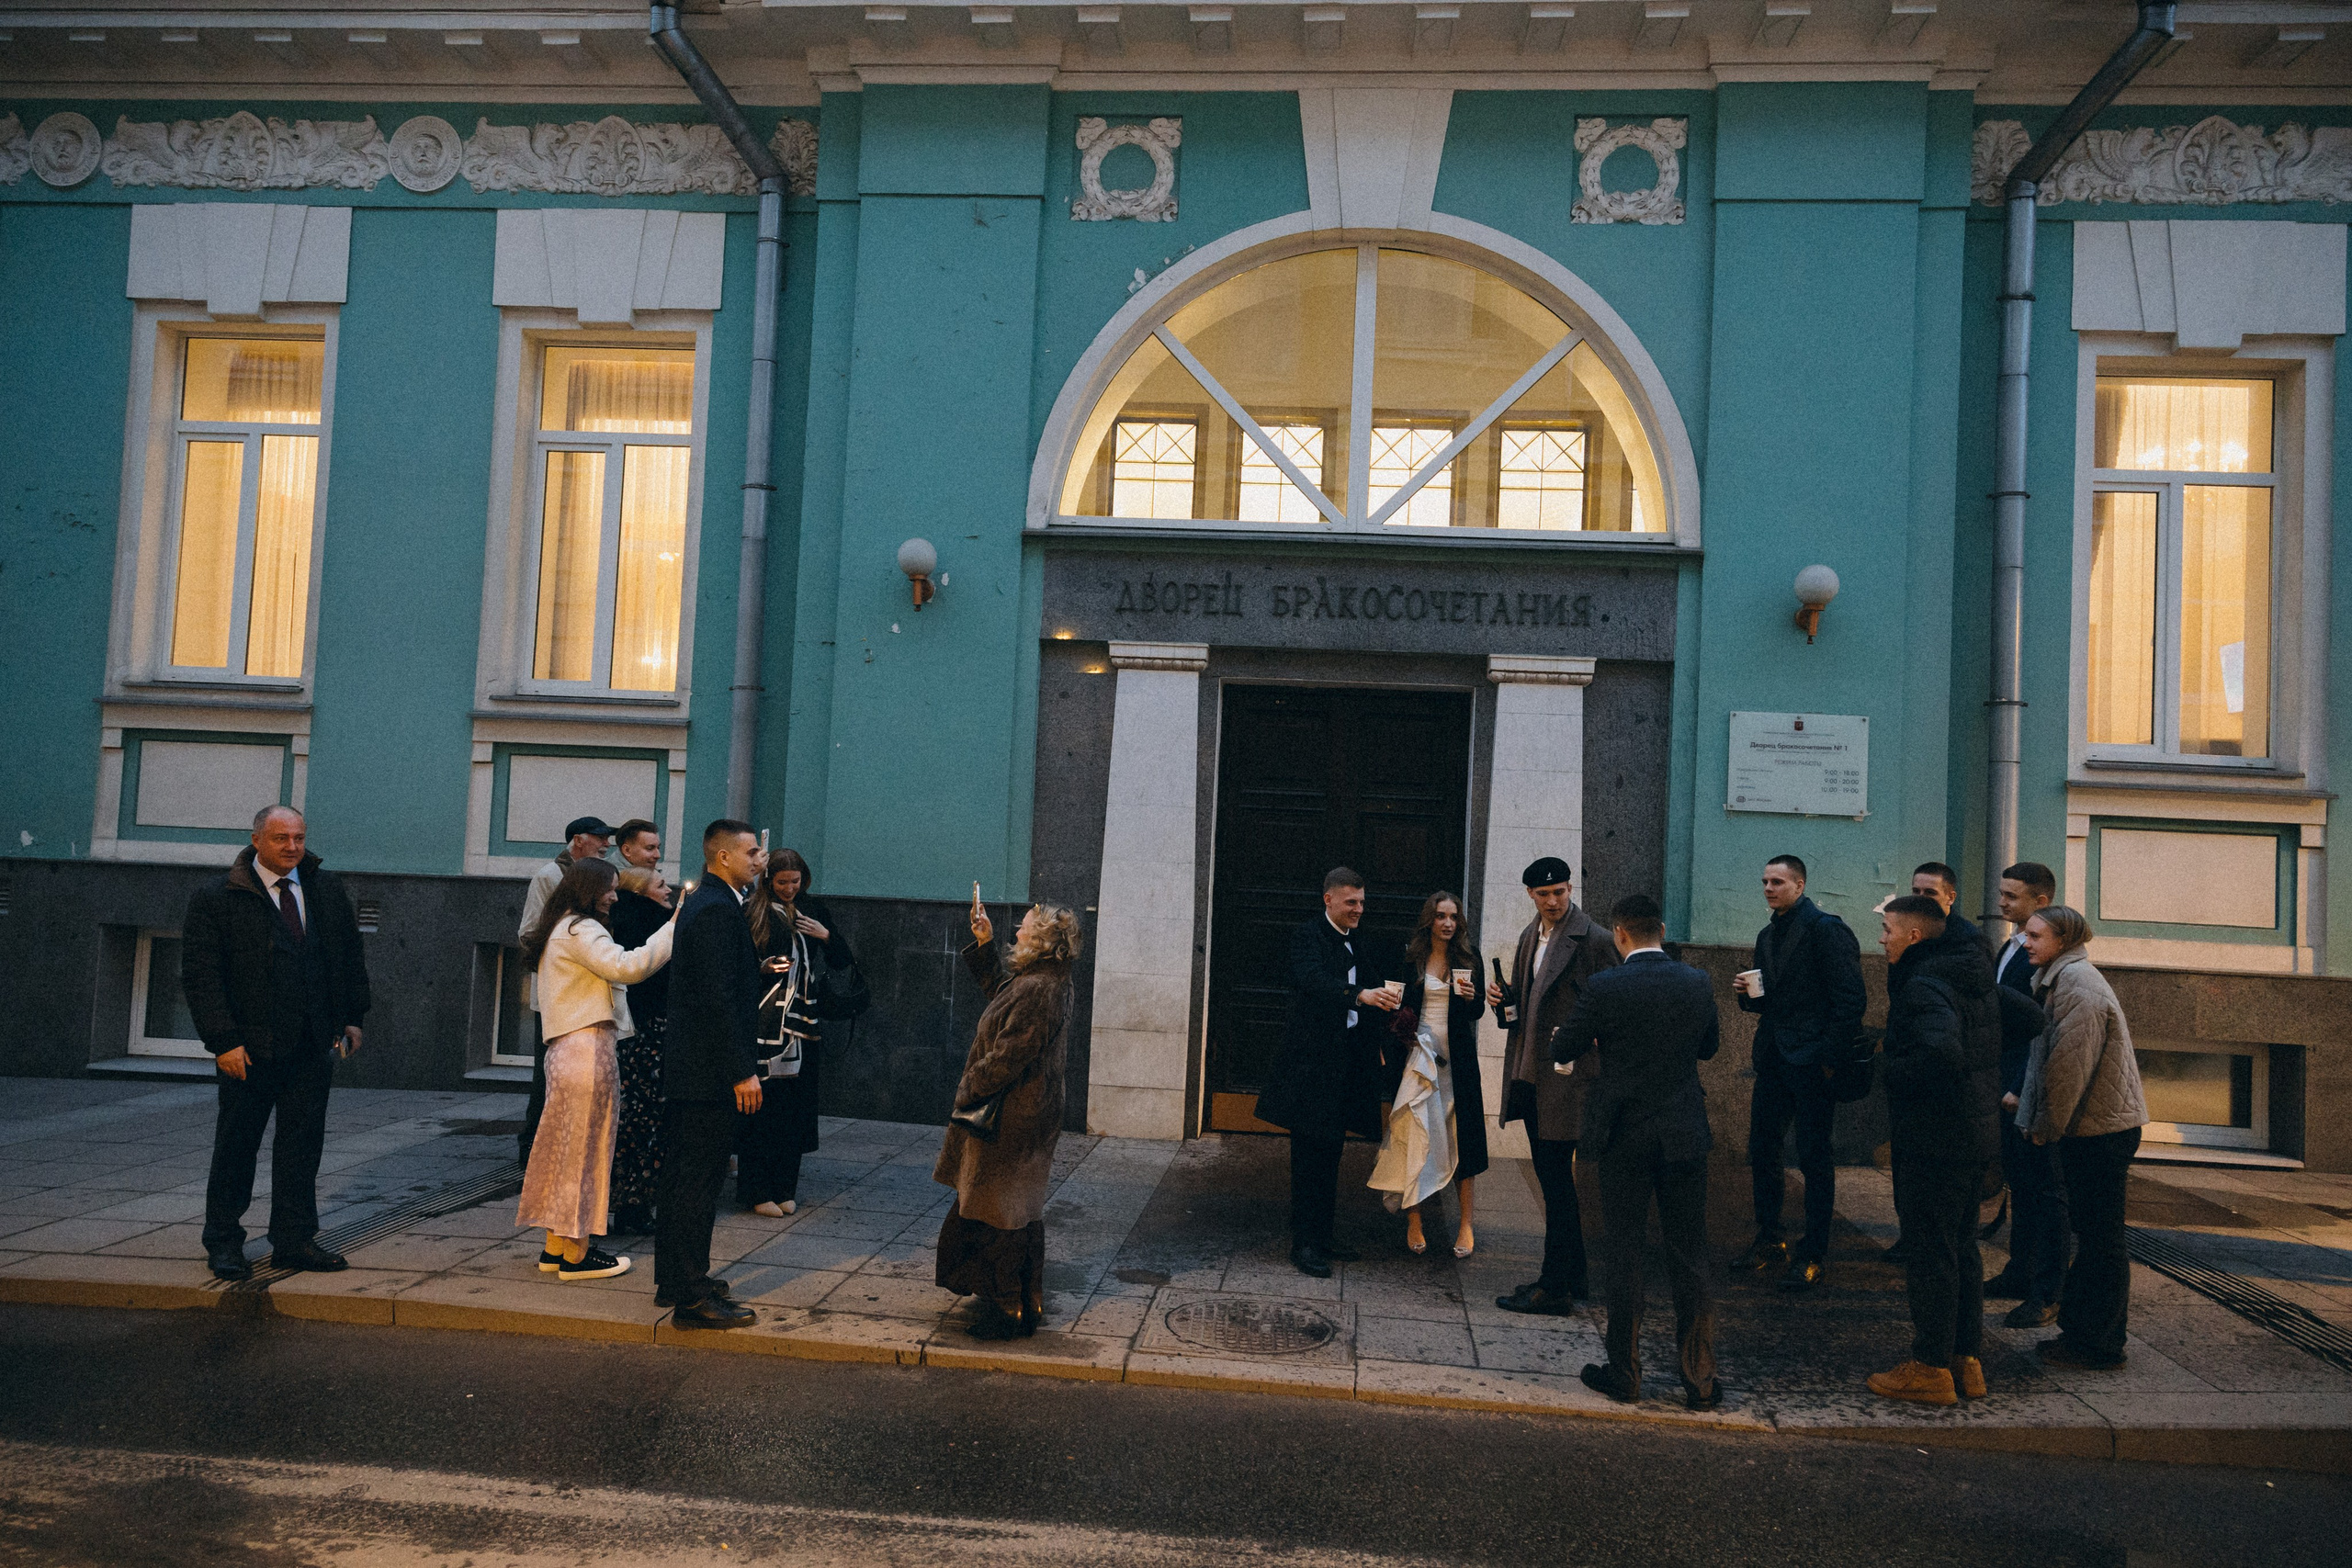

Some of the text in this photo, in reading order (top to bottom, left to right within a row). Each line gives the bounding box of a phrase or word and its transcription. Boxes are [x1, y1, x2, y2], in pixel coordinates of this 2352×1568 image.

[1114, 580, 1592, 627] ДВОРЕЦ БРАКОСОЧЕТАНИЯ
[1749, 741, 1776, 750] Дворец
[1777, 742, 1832, 751] бракосочетания
